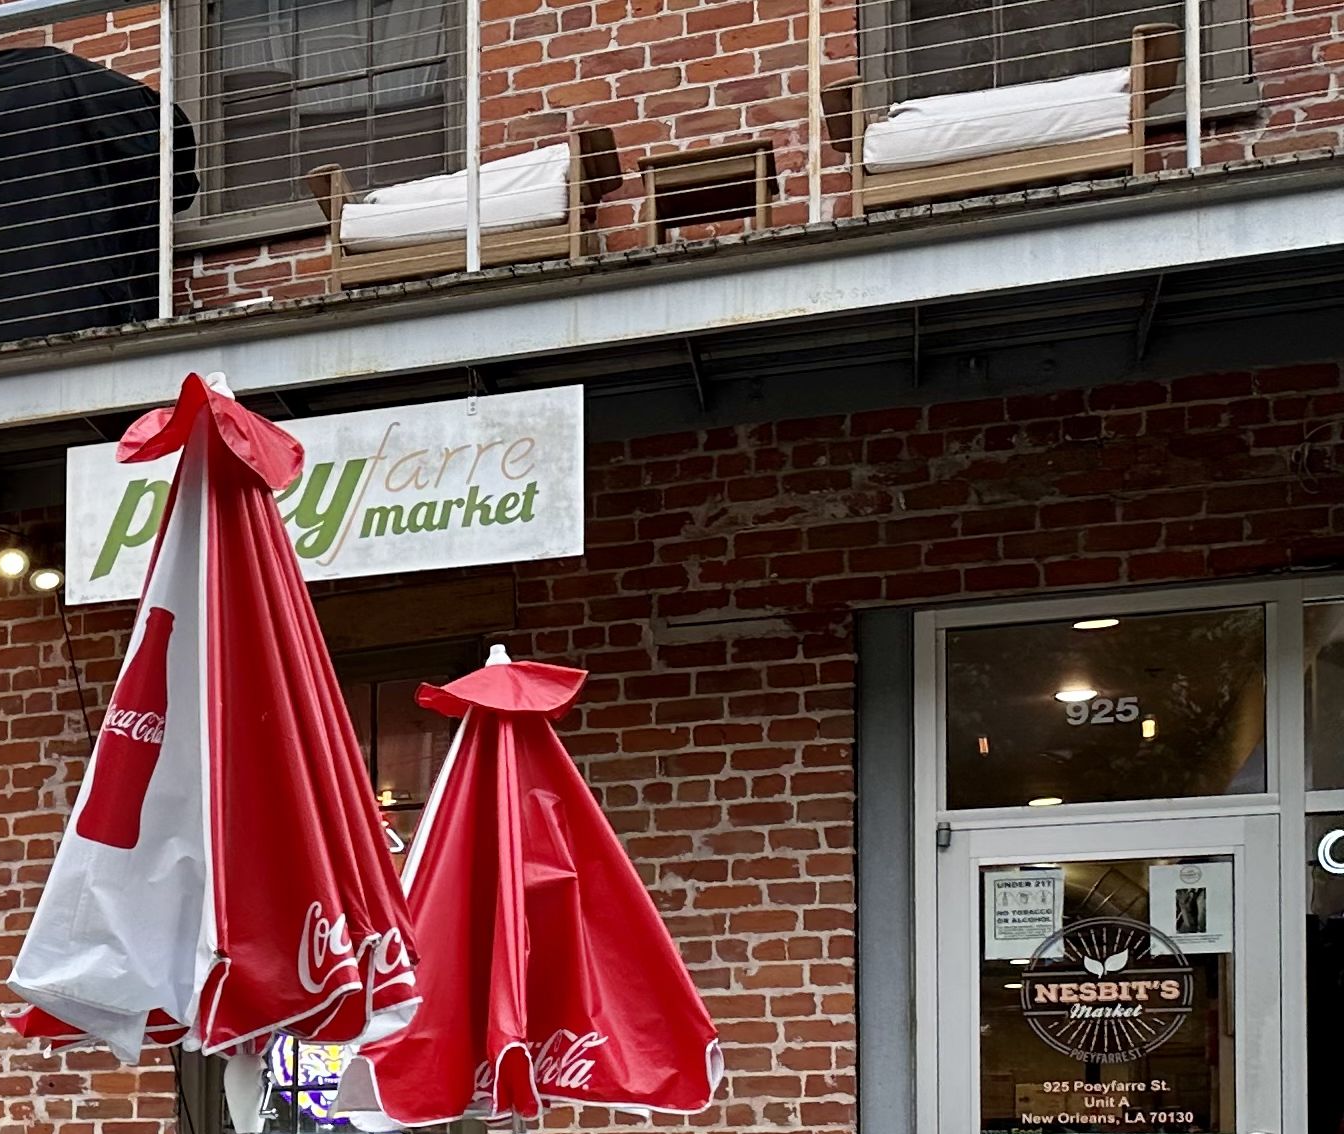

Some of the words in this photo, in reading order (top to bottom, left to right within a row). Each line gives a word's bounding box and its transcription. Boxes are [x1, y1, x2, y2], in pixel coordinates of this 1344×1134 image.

[88, 420, 537, 581] pyfarre
[358, 480, 540, 540] market
[103, 703, 165, 744] oca-Cola
[1064, 696, 1140, 727] 925
[1033, 980, 1181, 1004] NESBIT'S
[1069, 1003, 1143, 1019] Market
[1043, 1080, 1070, 1092] 925
[1073, 1080, 1146, 1095] Poeyfarre
[1150, 1080, 1169, 1092] St.
[1084, 1096, 1114, 1108] Unit
[1118, 1096, 1130, 1107] A
[1022, 1112, 1053, 1124] New
[1057, 1112, 1119, 1126] Orleans,
[1124, 1112, 1146, 1123] LA
[1149, 1111, 1194, 1123] 70130
